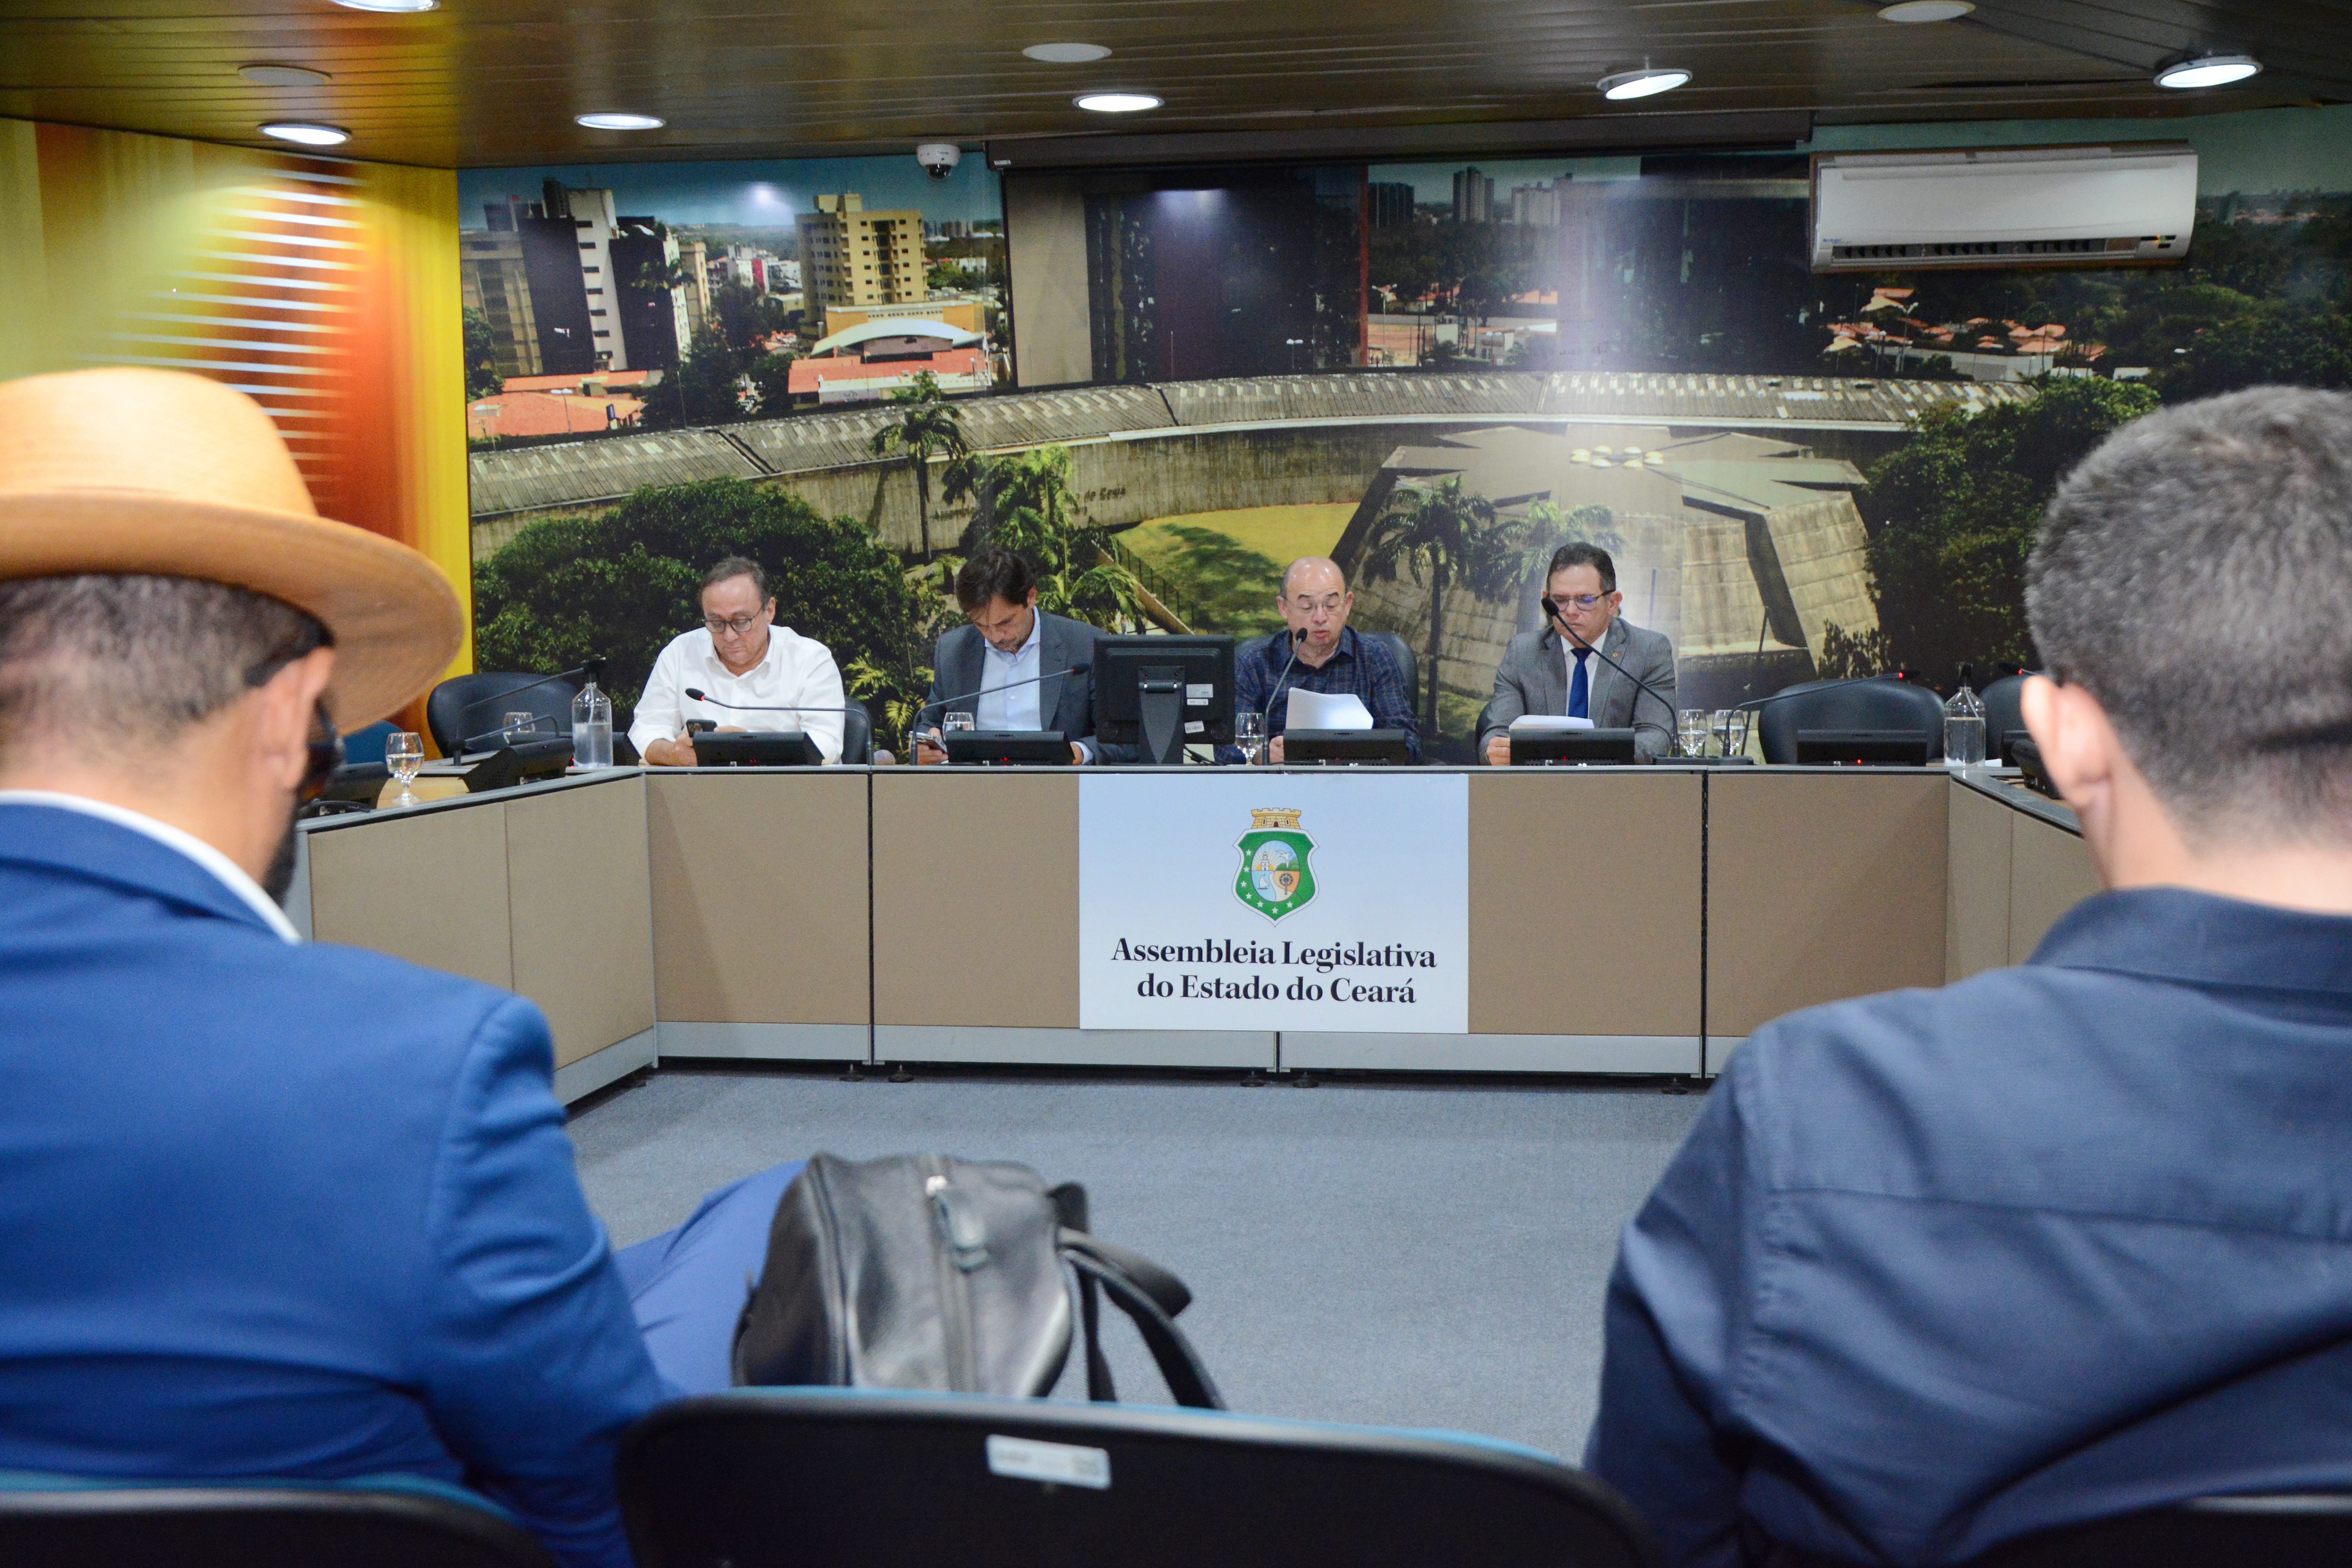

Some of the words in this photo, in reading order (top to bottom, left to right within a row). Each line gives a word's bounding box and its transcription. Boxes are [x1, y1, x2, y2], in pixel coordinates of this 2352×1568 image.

[1111, 937, 1276, 964] Assembleia
[1281, 941, 1437, 973] Legislativa
[1137, 973, 1174, 998] do
[1180, 975, 1279, 1000] Estado
[1286, 976, 1323, 1001] do
[1330, 977, 1416, 1004] Ceará
